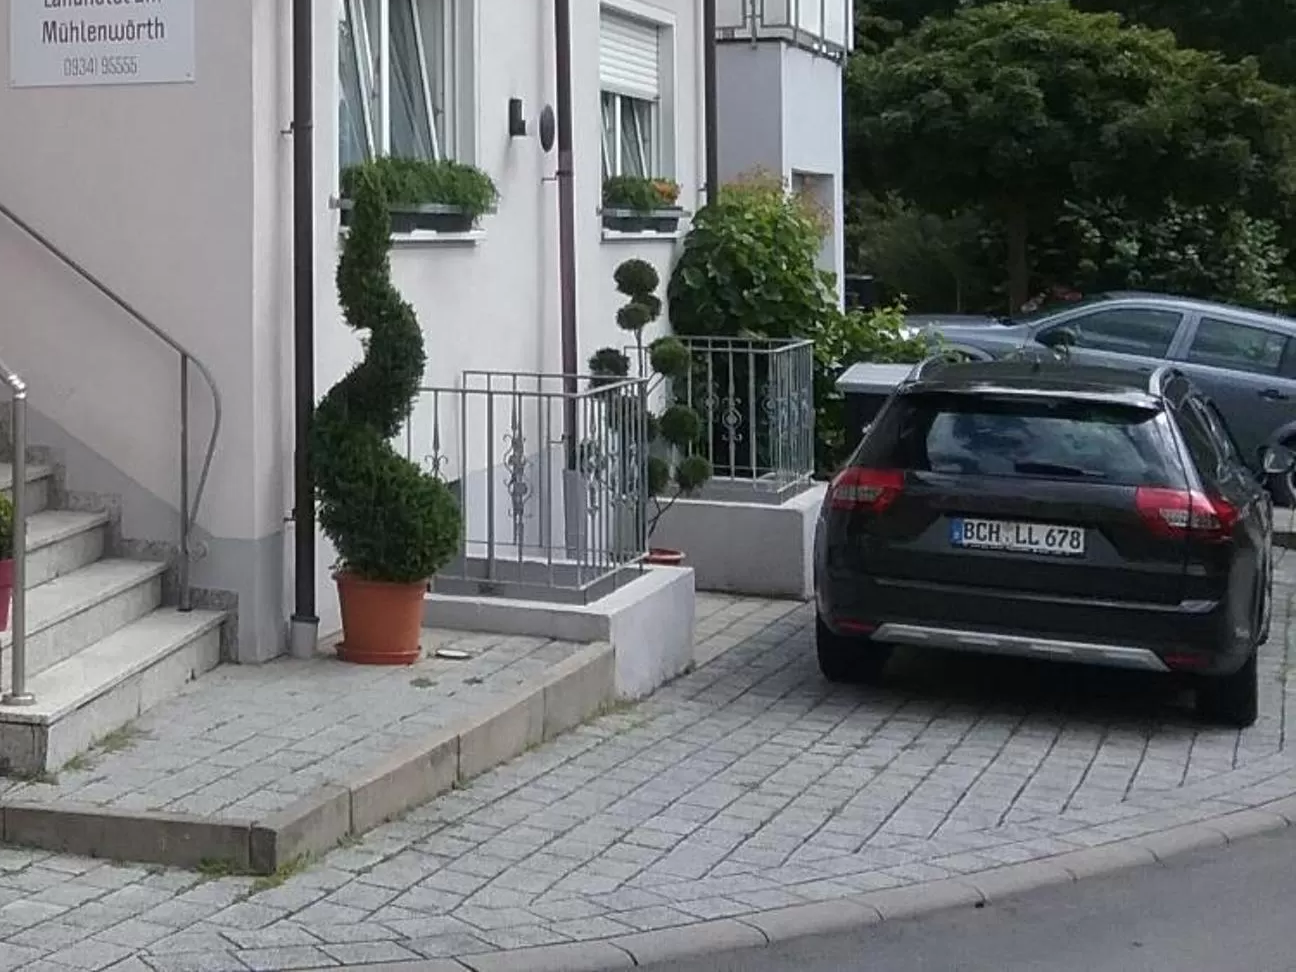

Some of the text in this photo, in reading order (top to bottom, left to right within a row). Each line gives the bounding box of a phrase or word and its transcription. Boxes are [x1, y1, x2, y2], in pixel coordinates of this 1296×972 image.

[42, 17, 165, 44] Mühlenwörth
[964, 522, 1081, 549] BCH LL 678
